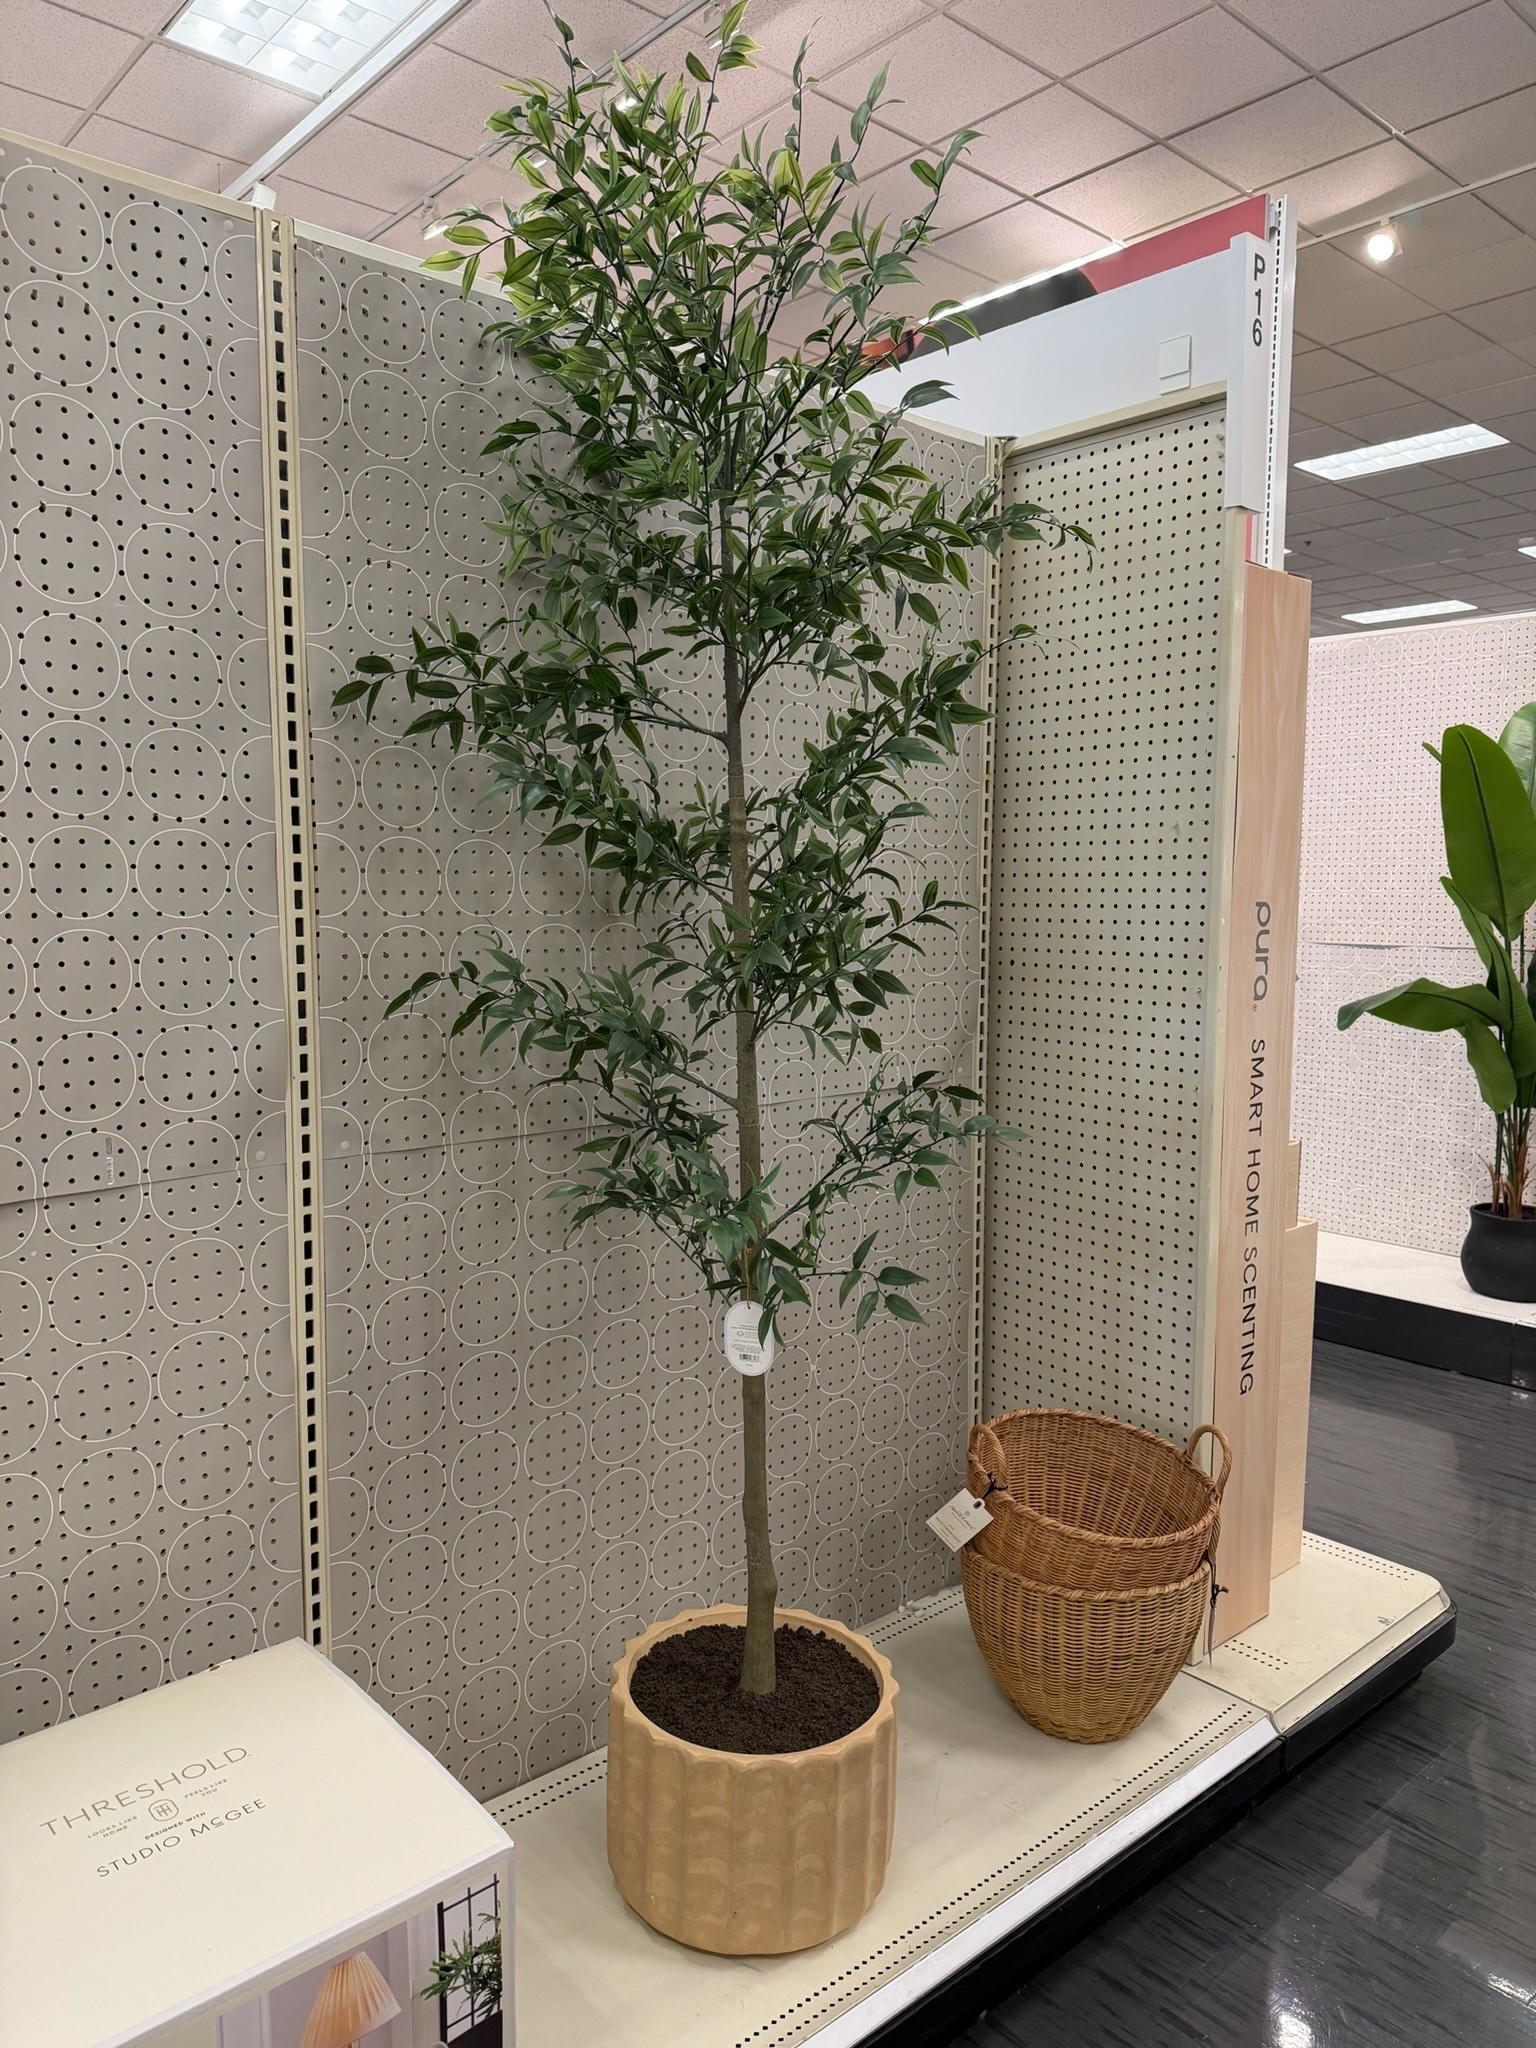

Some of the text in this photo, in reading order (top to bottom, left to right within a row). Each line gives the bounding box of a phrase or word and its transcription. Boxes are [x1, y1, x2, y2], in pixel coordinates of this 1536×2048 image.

[1248, 1038, 1266, 1137] SMART
[1244, 1149, 1261, 1237] HOME
[1239, 1246, 1258, 1396] SCENTING
[39, 1747, 249, 1836] THRESHOLD
[184, 1778, 228, 1799] FEELS LIKE
[201, 1787, 218, 1797] YOU
[87, 1815, 138, 1839] LOOKS LIKE
[103, 1824, 129, 1839] HOME
[144, 1811, 206, 1841] DESIGNED WITH
[96, 1835, 181, 1878] STUDIO
